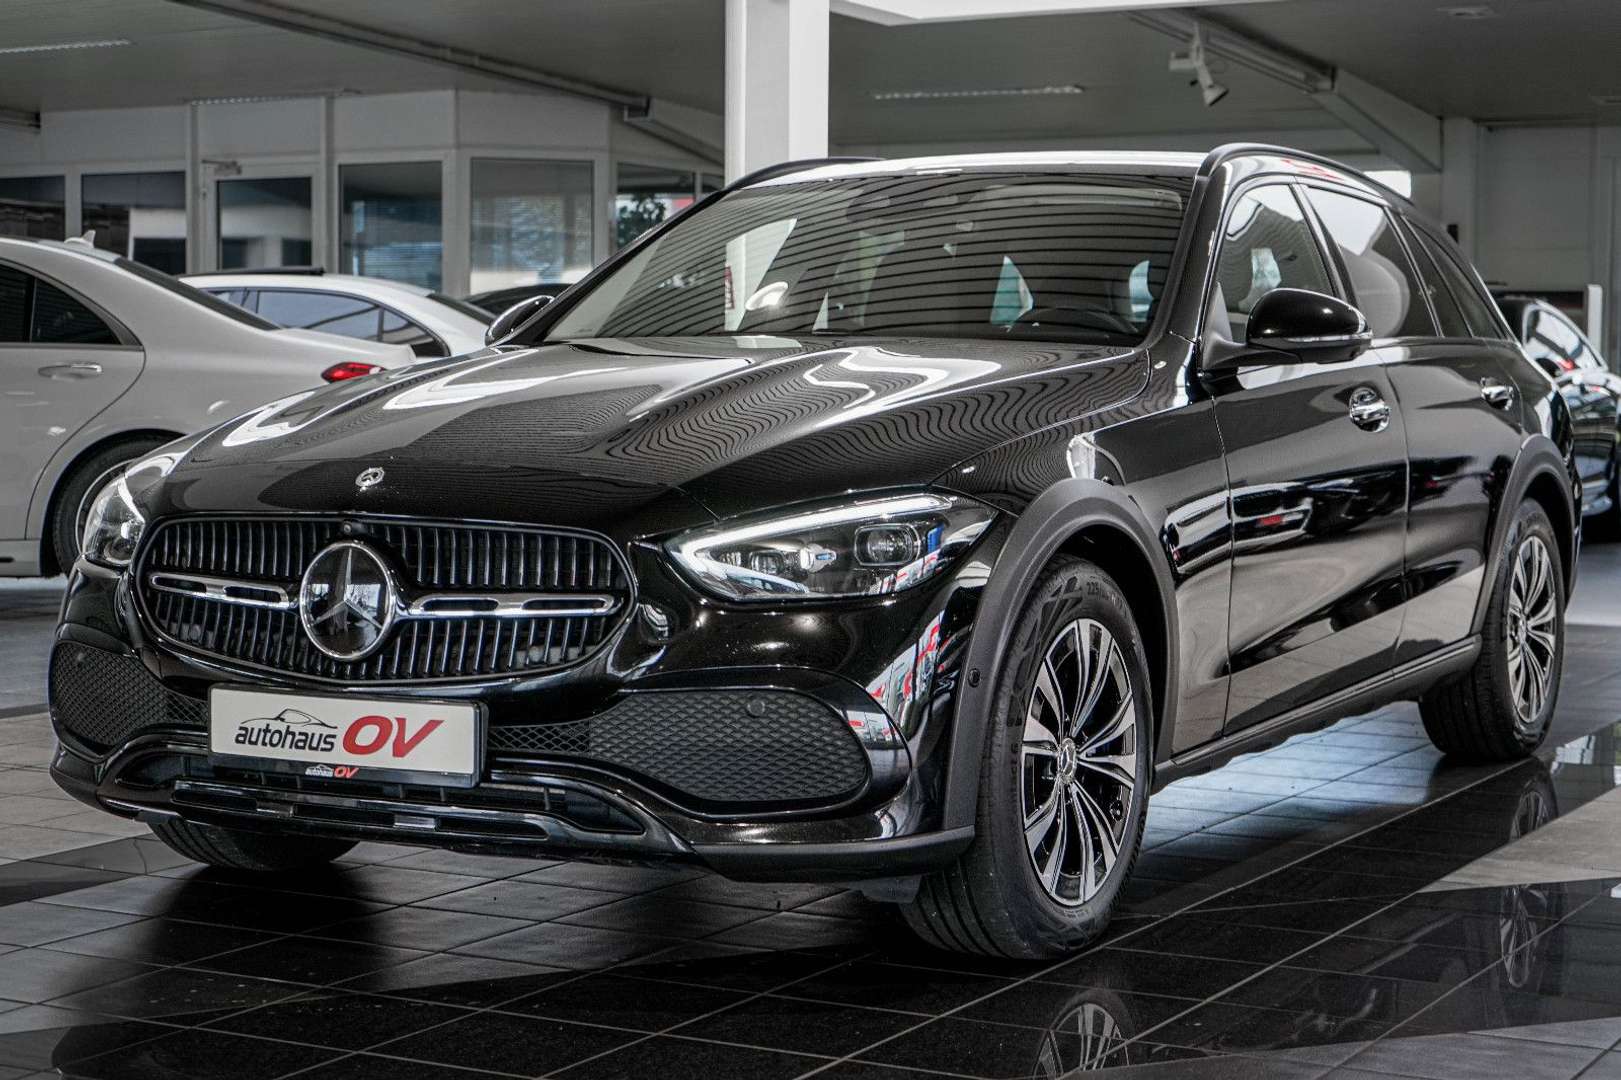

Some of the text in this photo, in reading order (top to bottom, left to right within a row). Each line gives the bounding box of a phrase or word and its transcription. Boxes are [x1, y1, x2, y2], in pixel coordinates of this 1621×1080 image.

[235, 715, 445, 758] autohaus OV
[334, 765, 360, 779] OV
